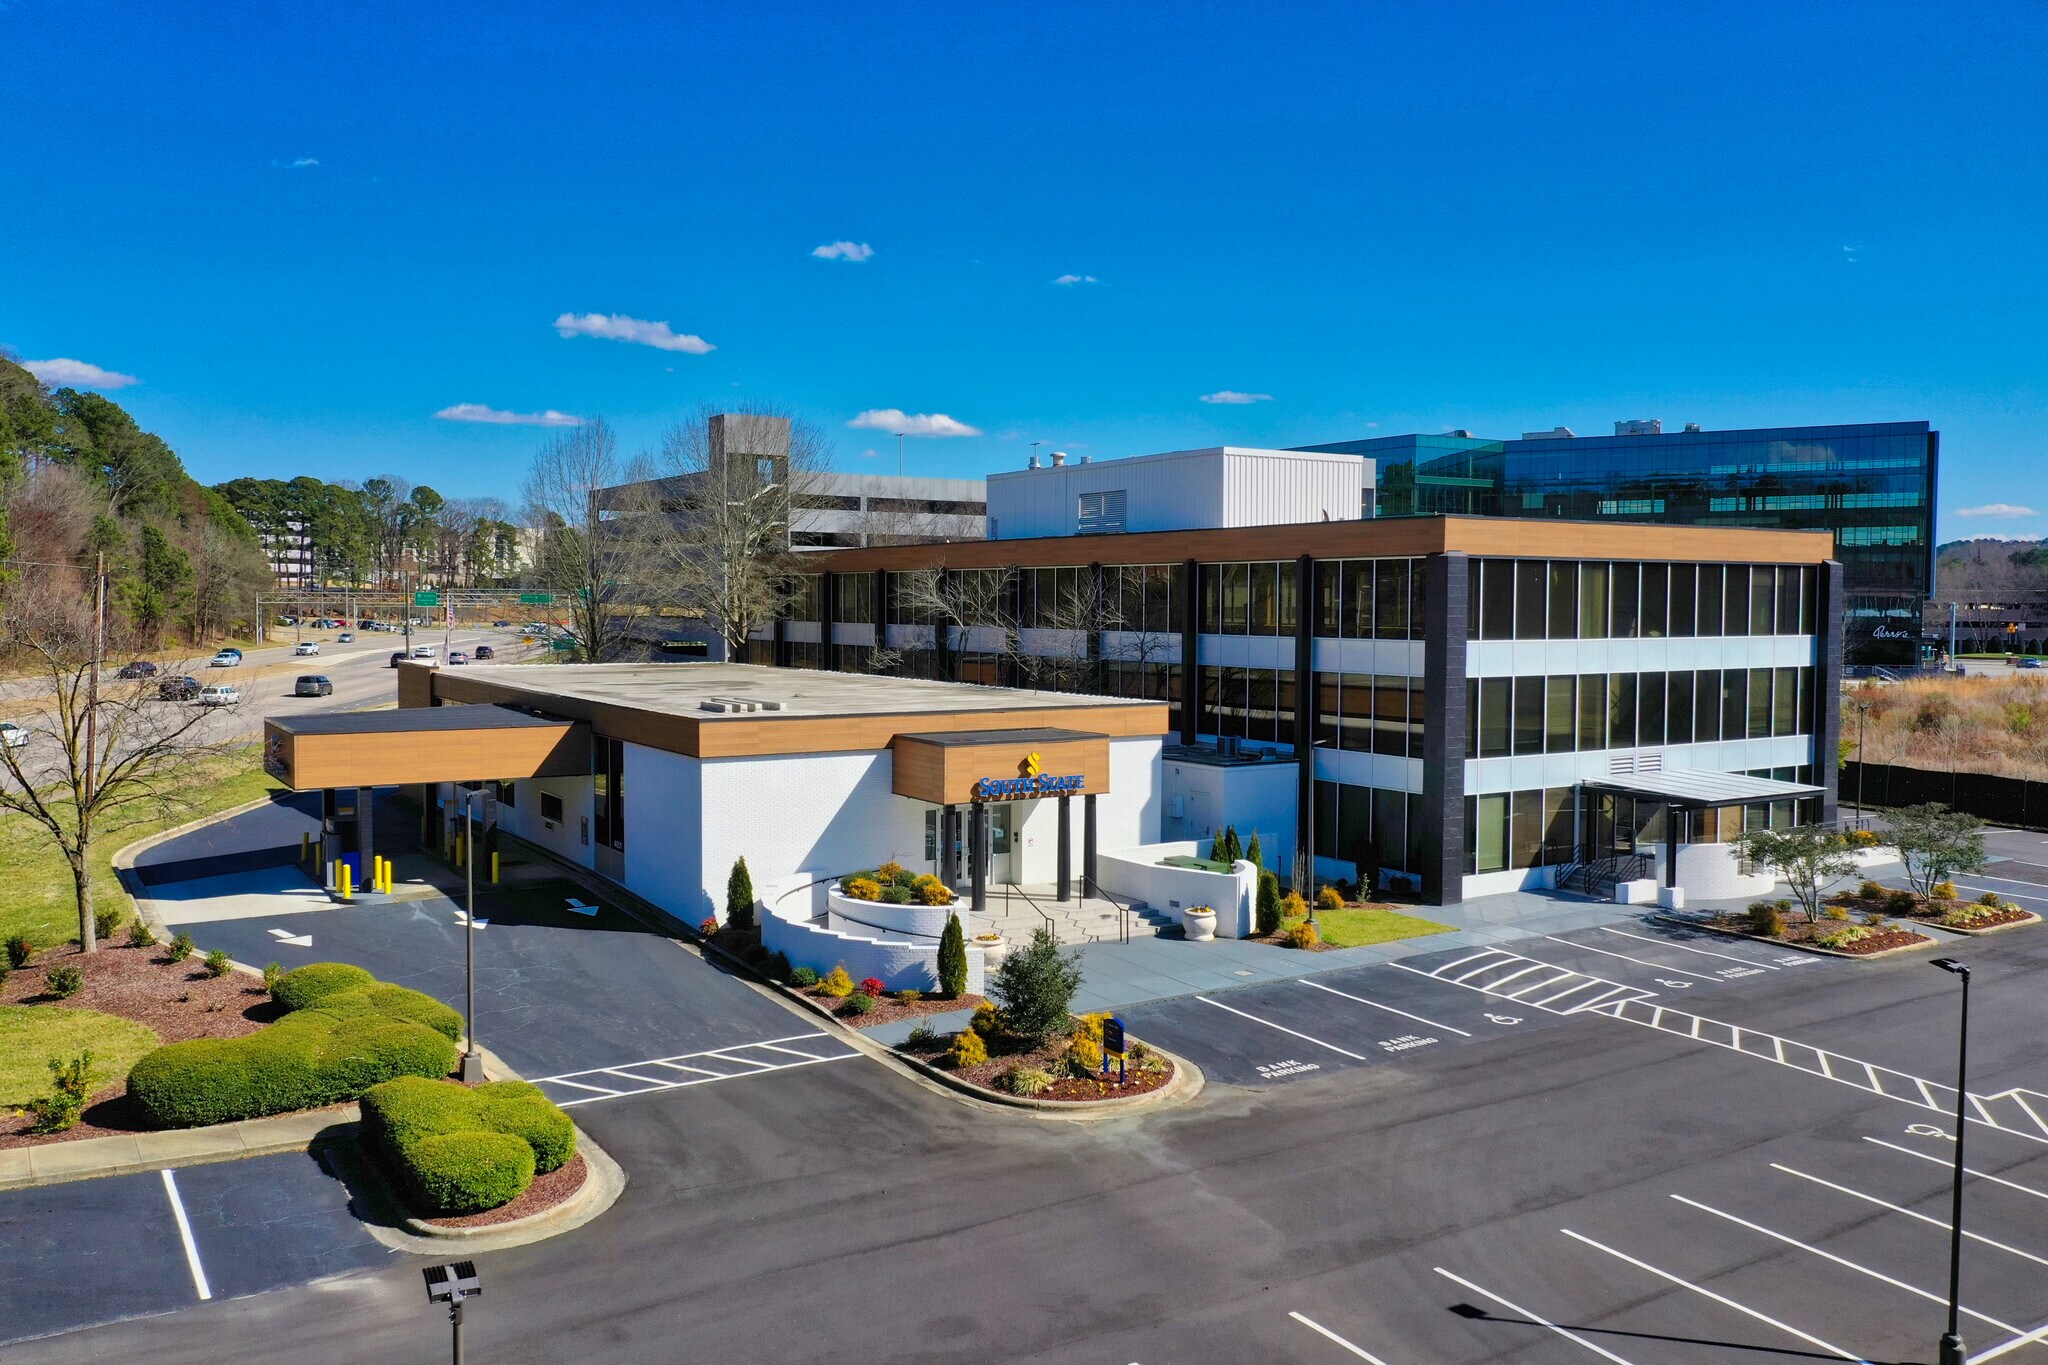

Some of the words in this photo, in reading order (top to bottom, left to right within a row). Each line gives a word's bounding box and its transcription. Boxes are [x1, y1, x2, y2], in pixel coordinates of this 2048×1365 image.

[980, 777, 1035, 796] SOUTH
[1039, 773, 1085, 792] STATE
[1377, 1034, 1420, 1047] BANK
[1384, 1037, 1439, 1053] PARKING
[1256, 1059, 1302, 1072] BANK
[1260, 1063, 1320, 1079] PARKING
